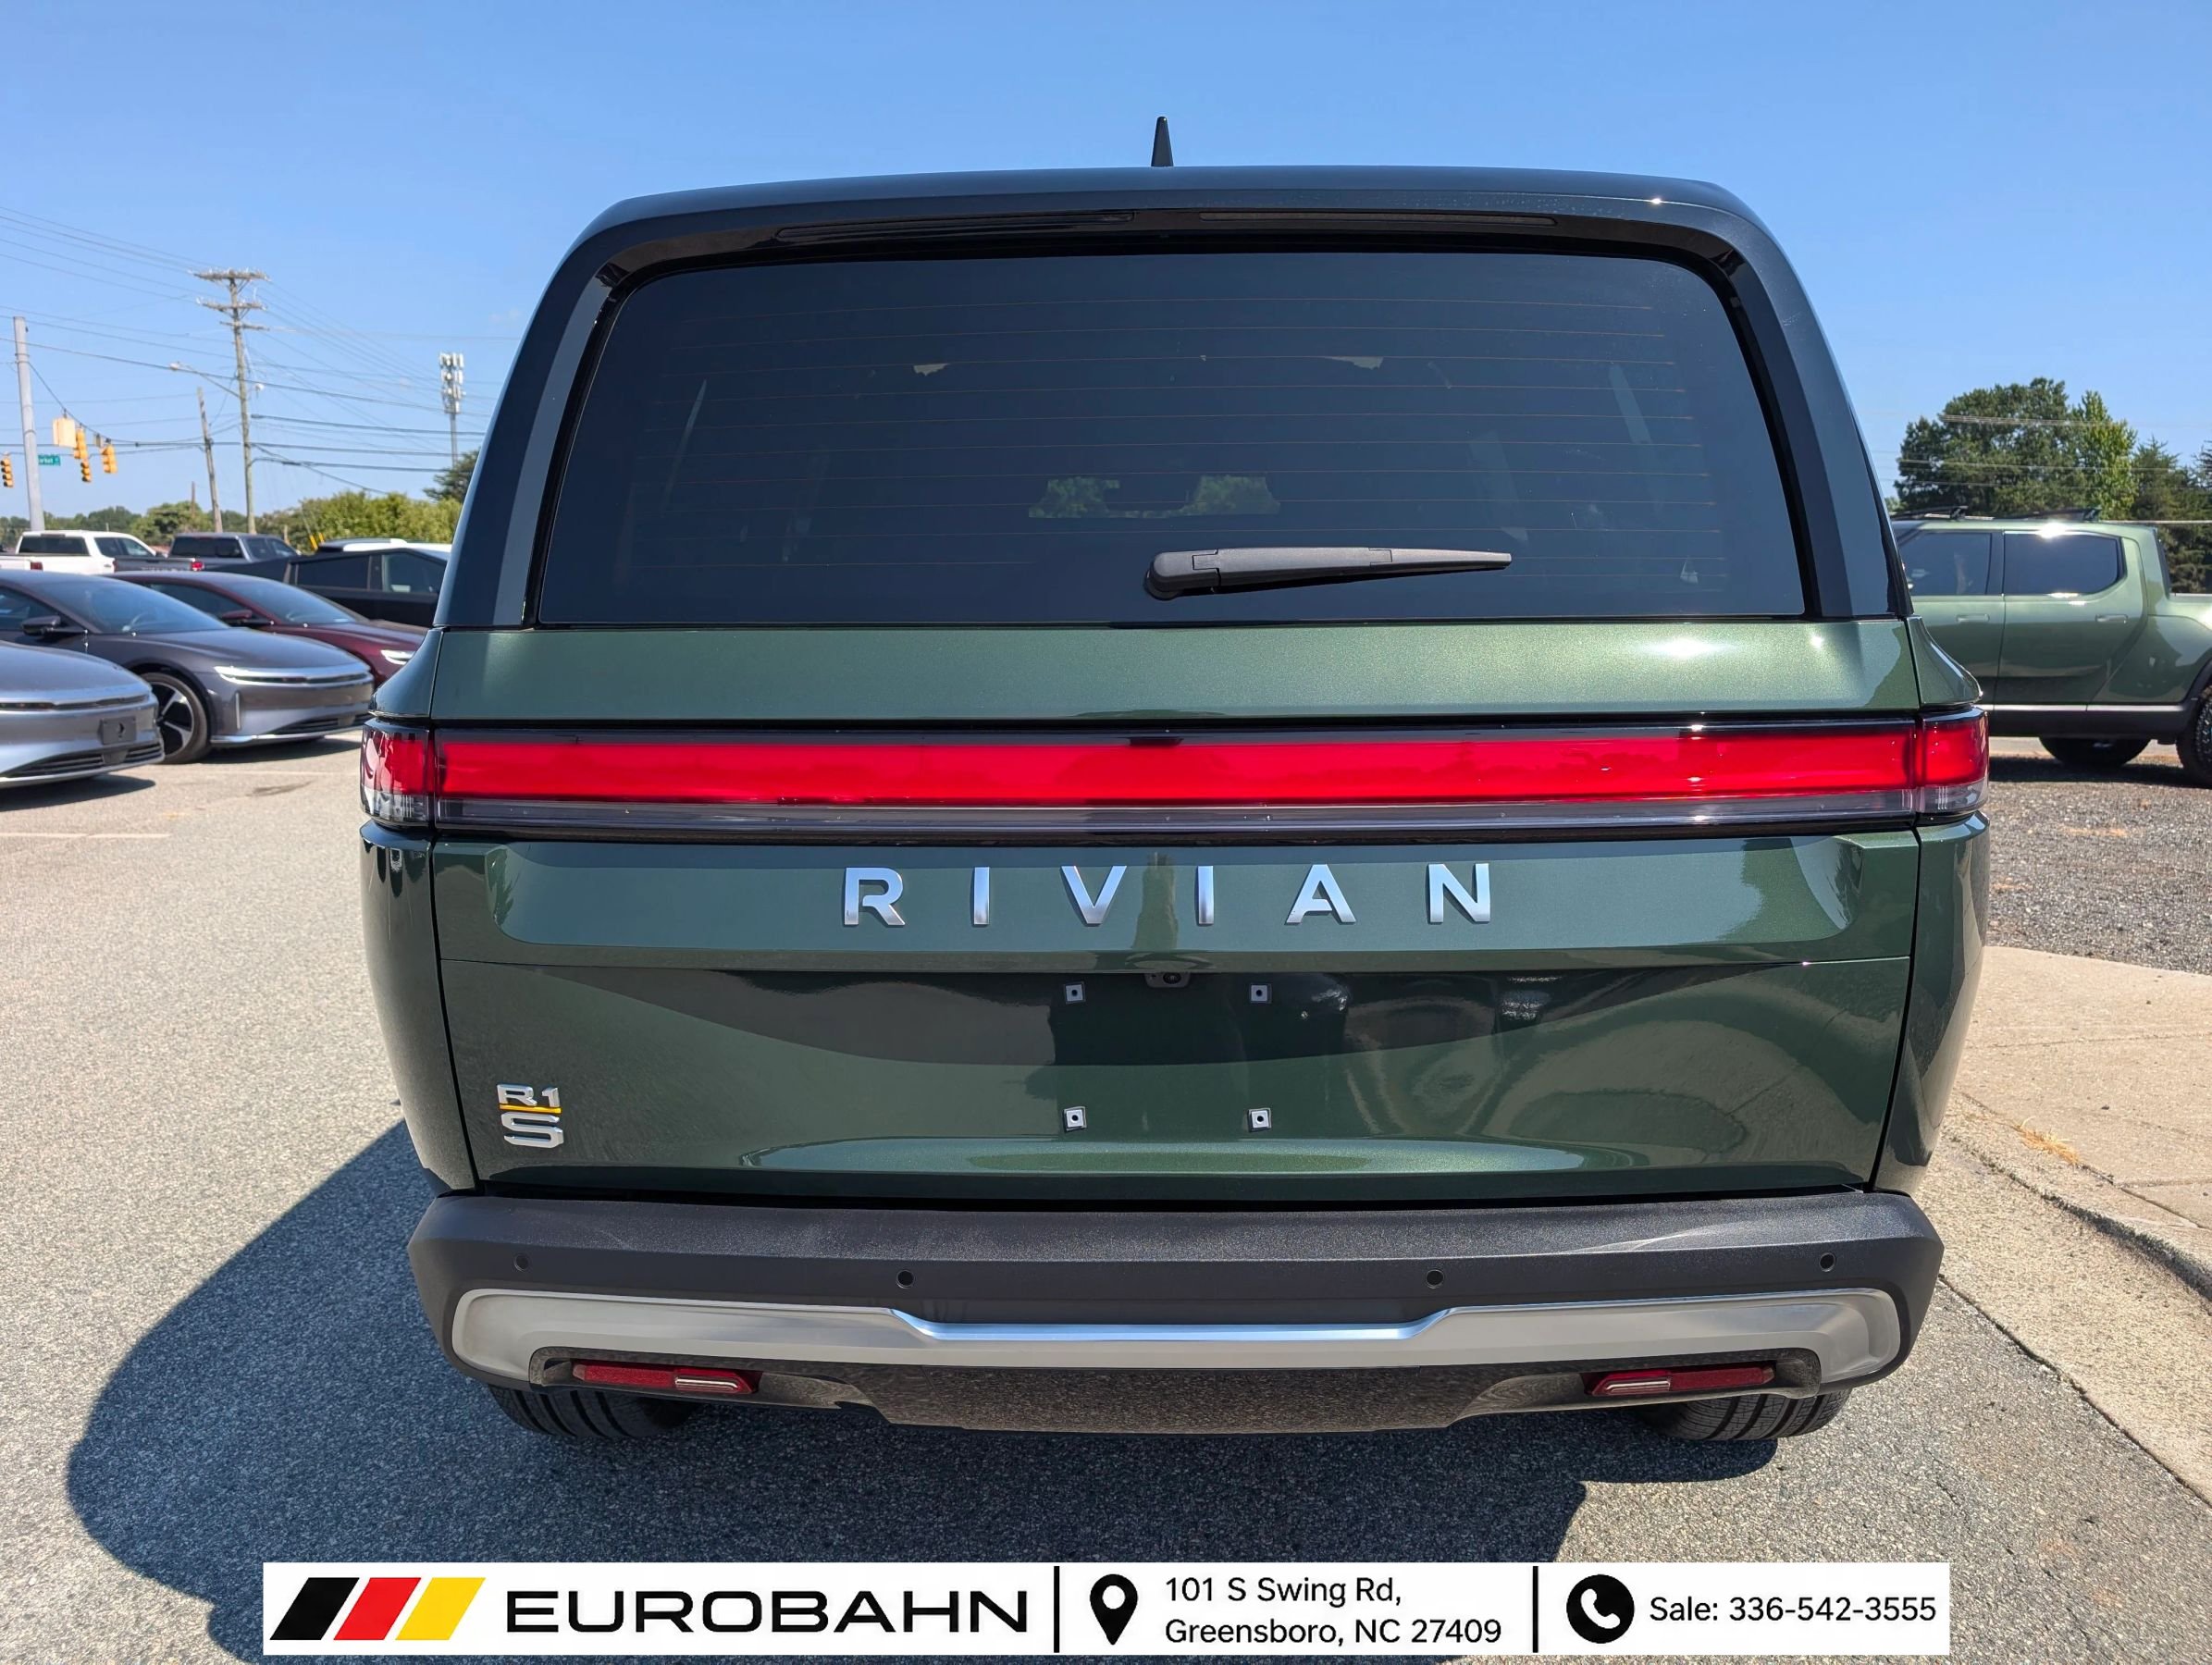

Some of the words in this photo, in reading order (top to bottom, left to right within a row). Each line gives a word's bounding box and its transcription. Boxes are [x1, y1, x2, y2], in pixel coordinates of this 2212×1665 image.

[844, 863, 1490, 927] RIVIAN
[497, 1084, 561, 1107] R1
[500, 1111, 564, 1149] S
